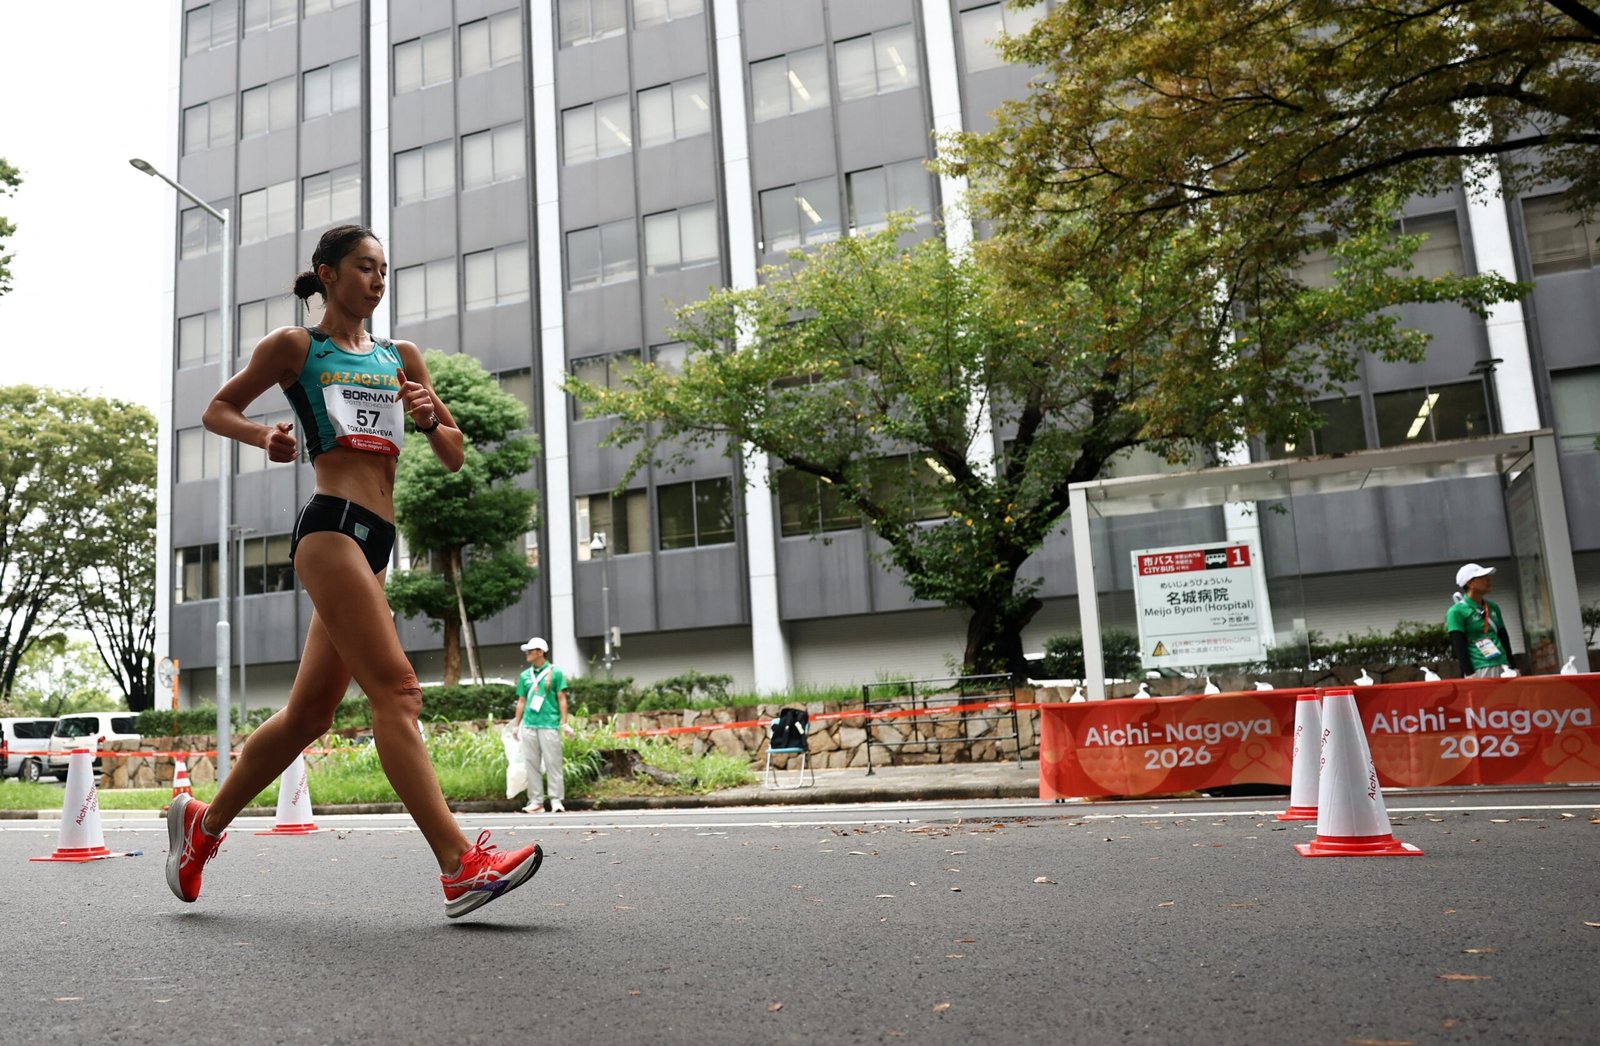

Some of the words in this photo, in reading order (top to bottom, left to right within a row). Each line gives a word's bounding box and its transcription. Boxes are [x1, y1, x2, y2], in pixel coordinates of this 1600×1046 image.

[342, 389, 394, 404] BORNAN
[356, 409, 381, 428] 57
[347, 424, 393, 437] TOXANBAYEVA
[1144, 555, 1174, 566] 市バス
[1232, 548, 1246, 566] 1
[1143, 566, 1161, 575] CITY
[1160, 565, 1176, 574] BUS
[1160, 577, 1233, 590] めいじょうびょういん
[1166, 587, 1230, 606] 名城病院
[1144, 605, 1172, 618] Meijo
[1174, 603, 1203, 616] Byoin
[1205, 600, 1254, 613] (Hospital)
[1370, 706, 1592, 734] Aichi-Nagoya
[1084, 718, 1272, 747] Aichi-Nagoya
[1439, 734, 1520, 760] 2026
[1144, 745, 1212, 770] 2026
